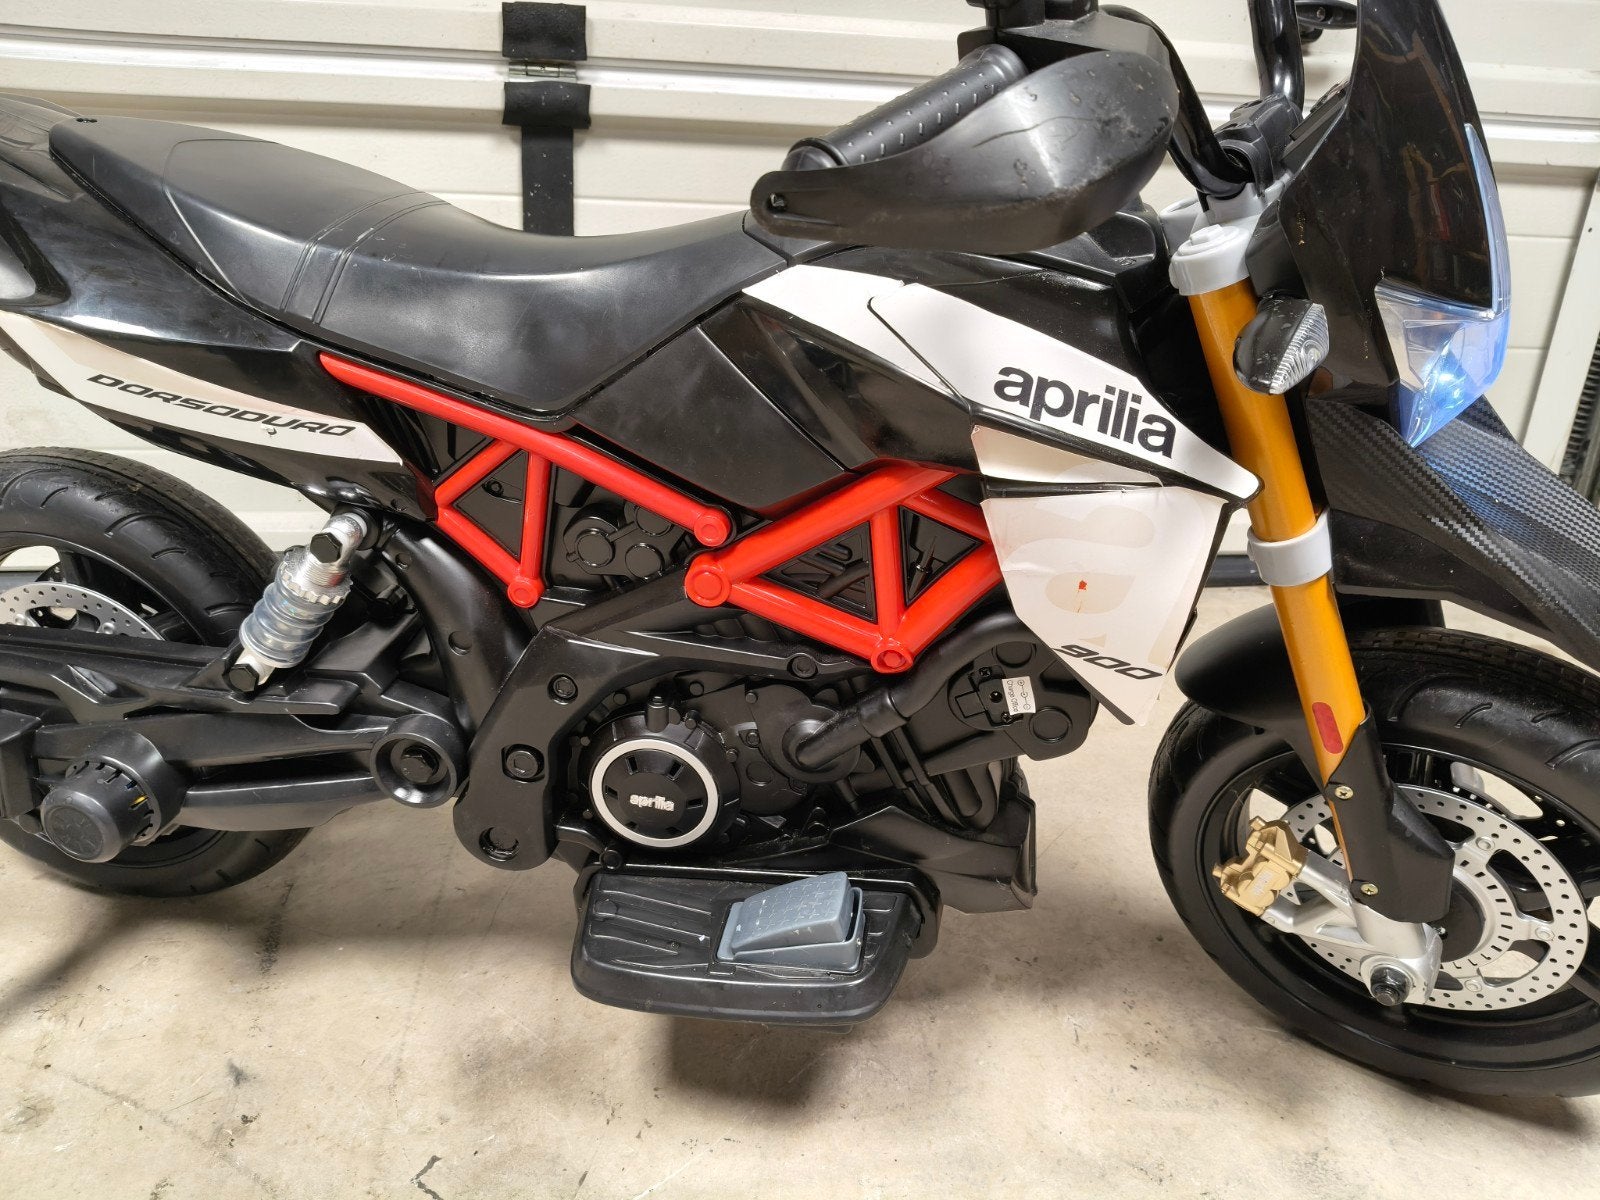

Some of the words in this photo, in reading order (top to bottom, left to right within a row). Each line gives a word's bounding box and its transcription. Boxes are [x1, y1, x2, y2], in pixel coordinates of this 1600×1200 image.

[86, 373, 356, 436] DORSODURO
[993, 366, 1176, 459] aprilia
[1052, 644, 1162, 680] 900
[629, 794, 675, 811] aprilia
